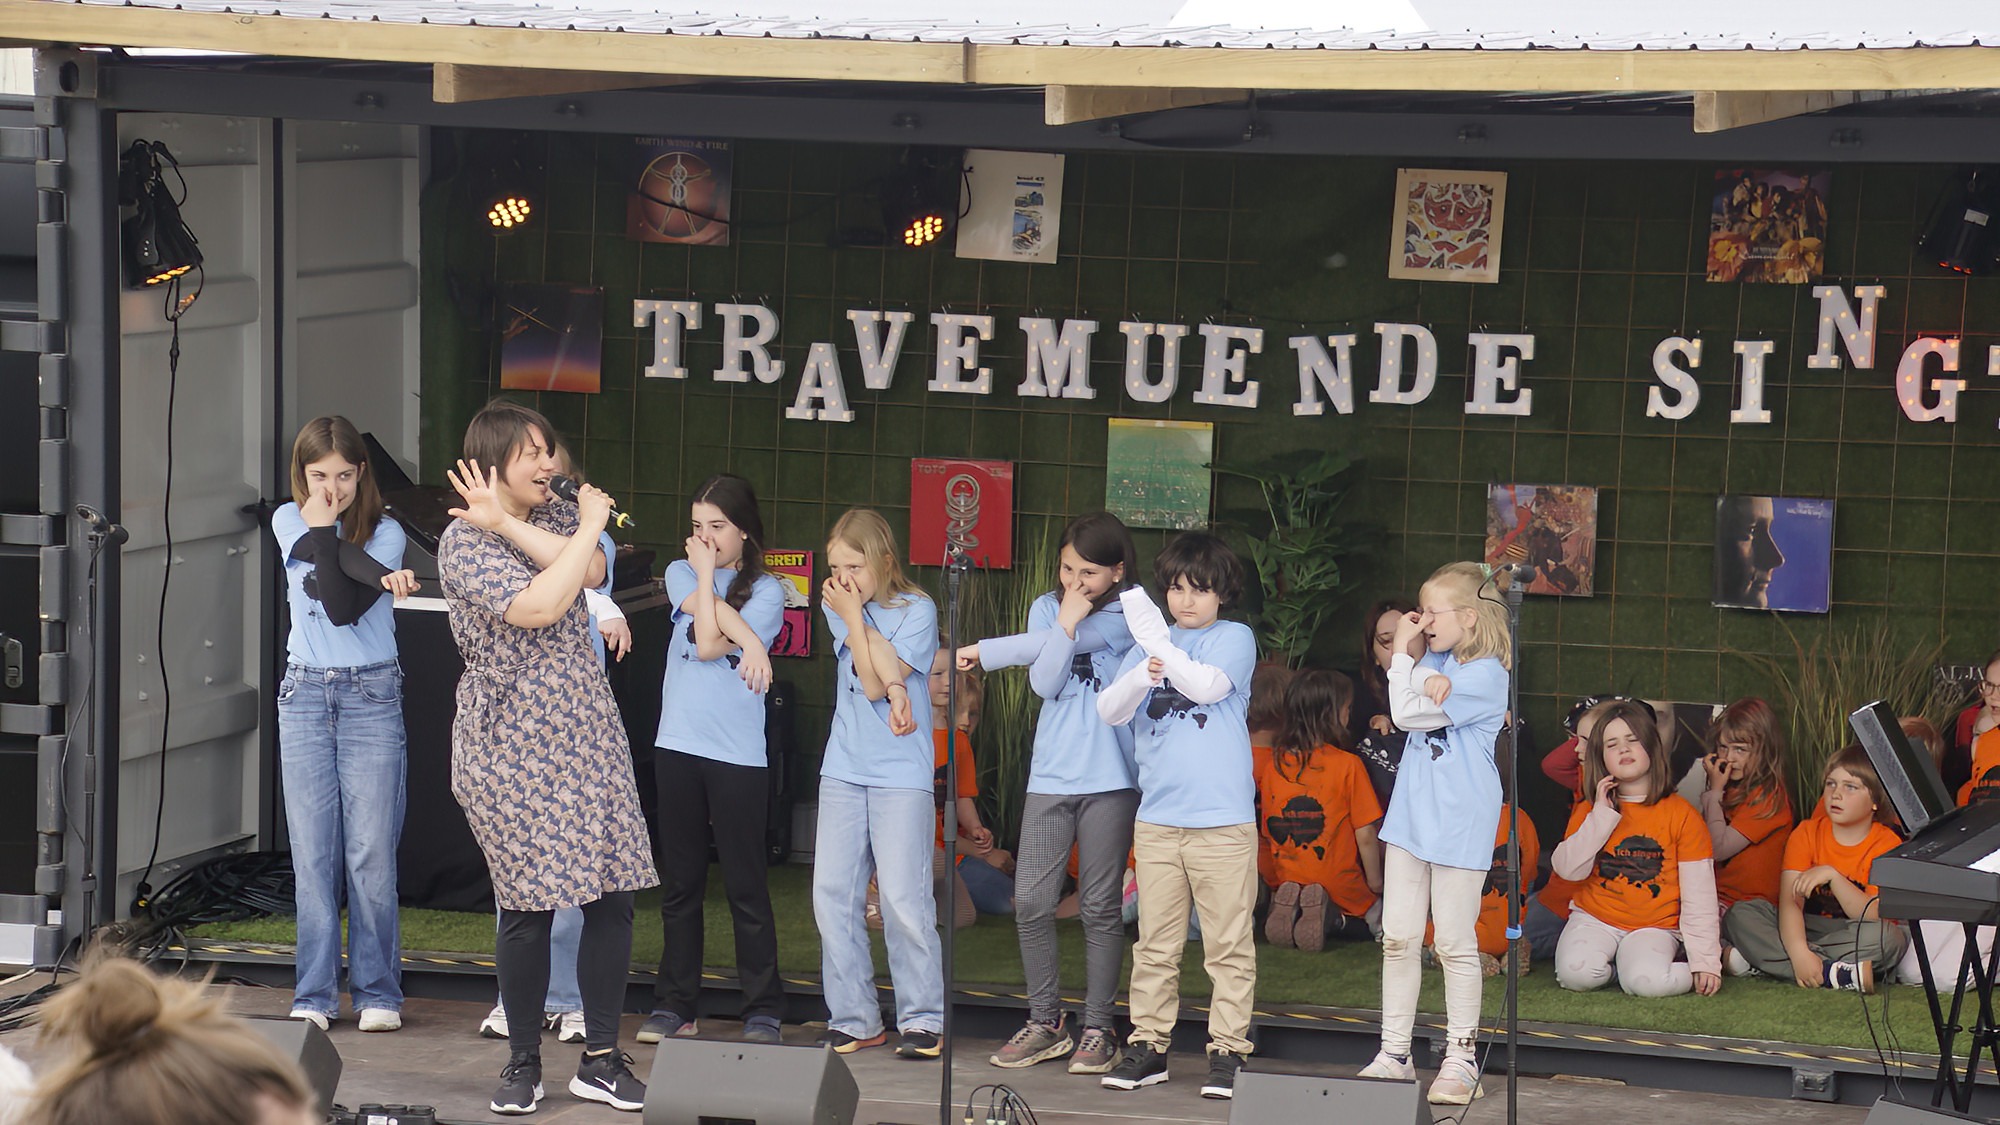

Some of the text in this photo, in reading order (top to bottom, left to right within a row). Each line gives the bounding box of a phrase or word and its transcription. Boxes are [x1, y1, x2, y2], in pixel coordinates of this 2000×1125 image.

[706, 142, 729, 151] FIRE
[633, 285, 2000, 424] TRAVEMUENDE SING
[918, 464, 946, 475] TOTO
